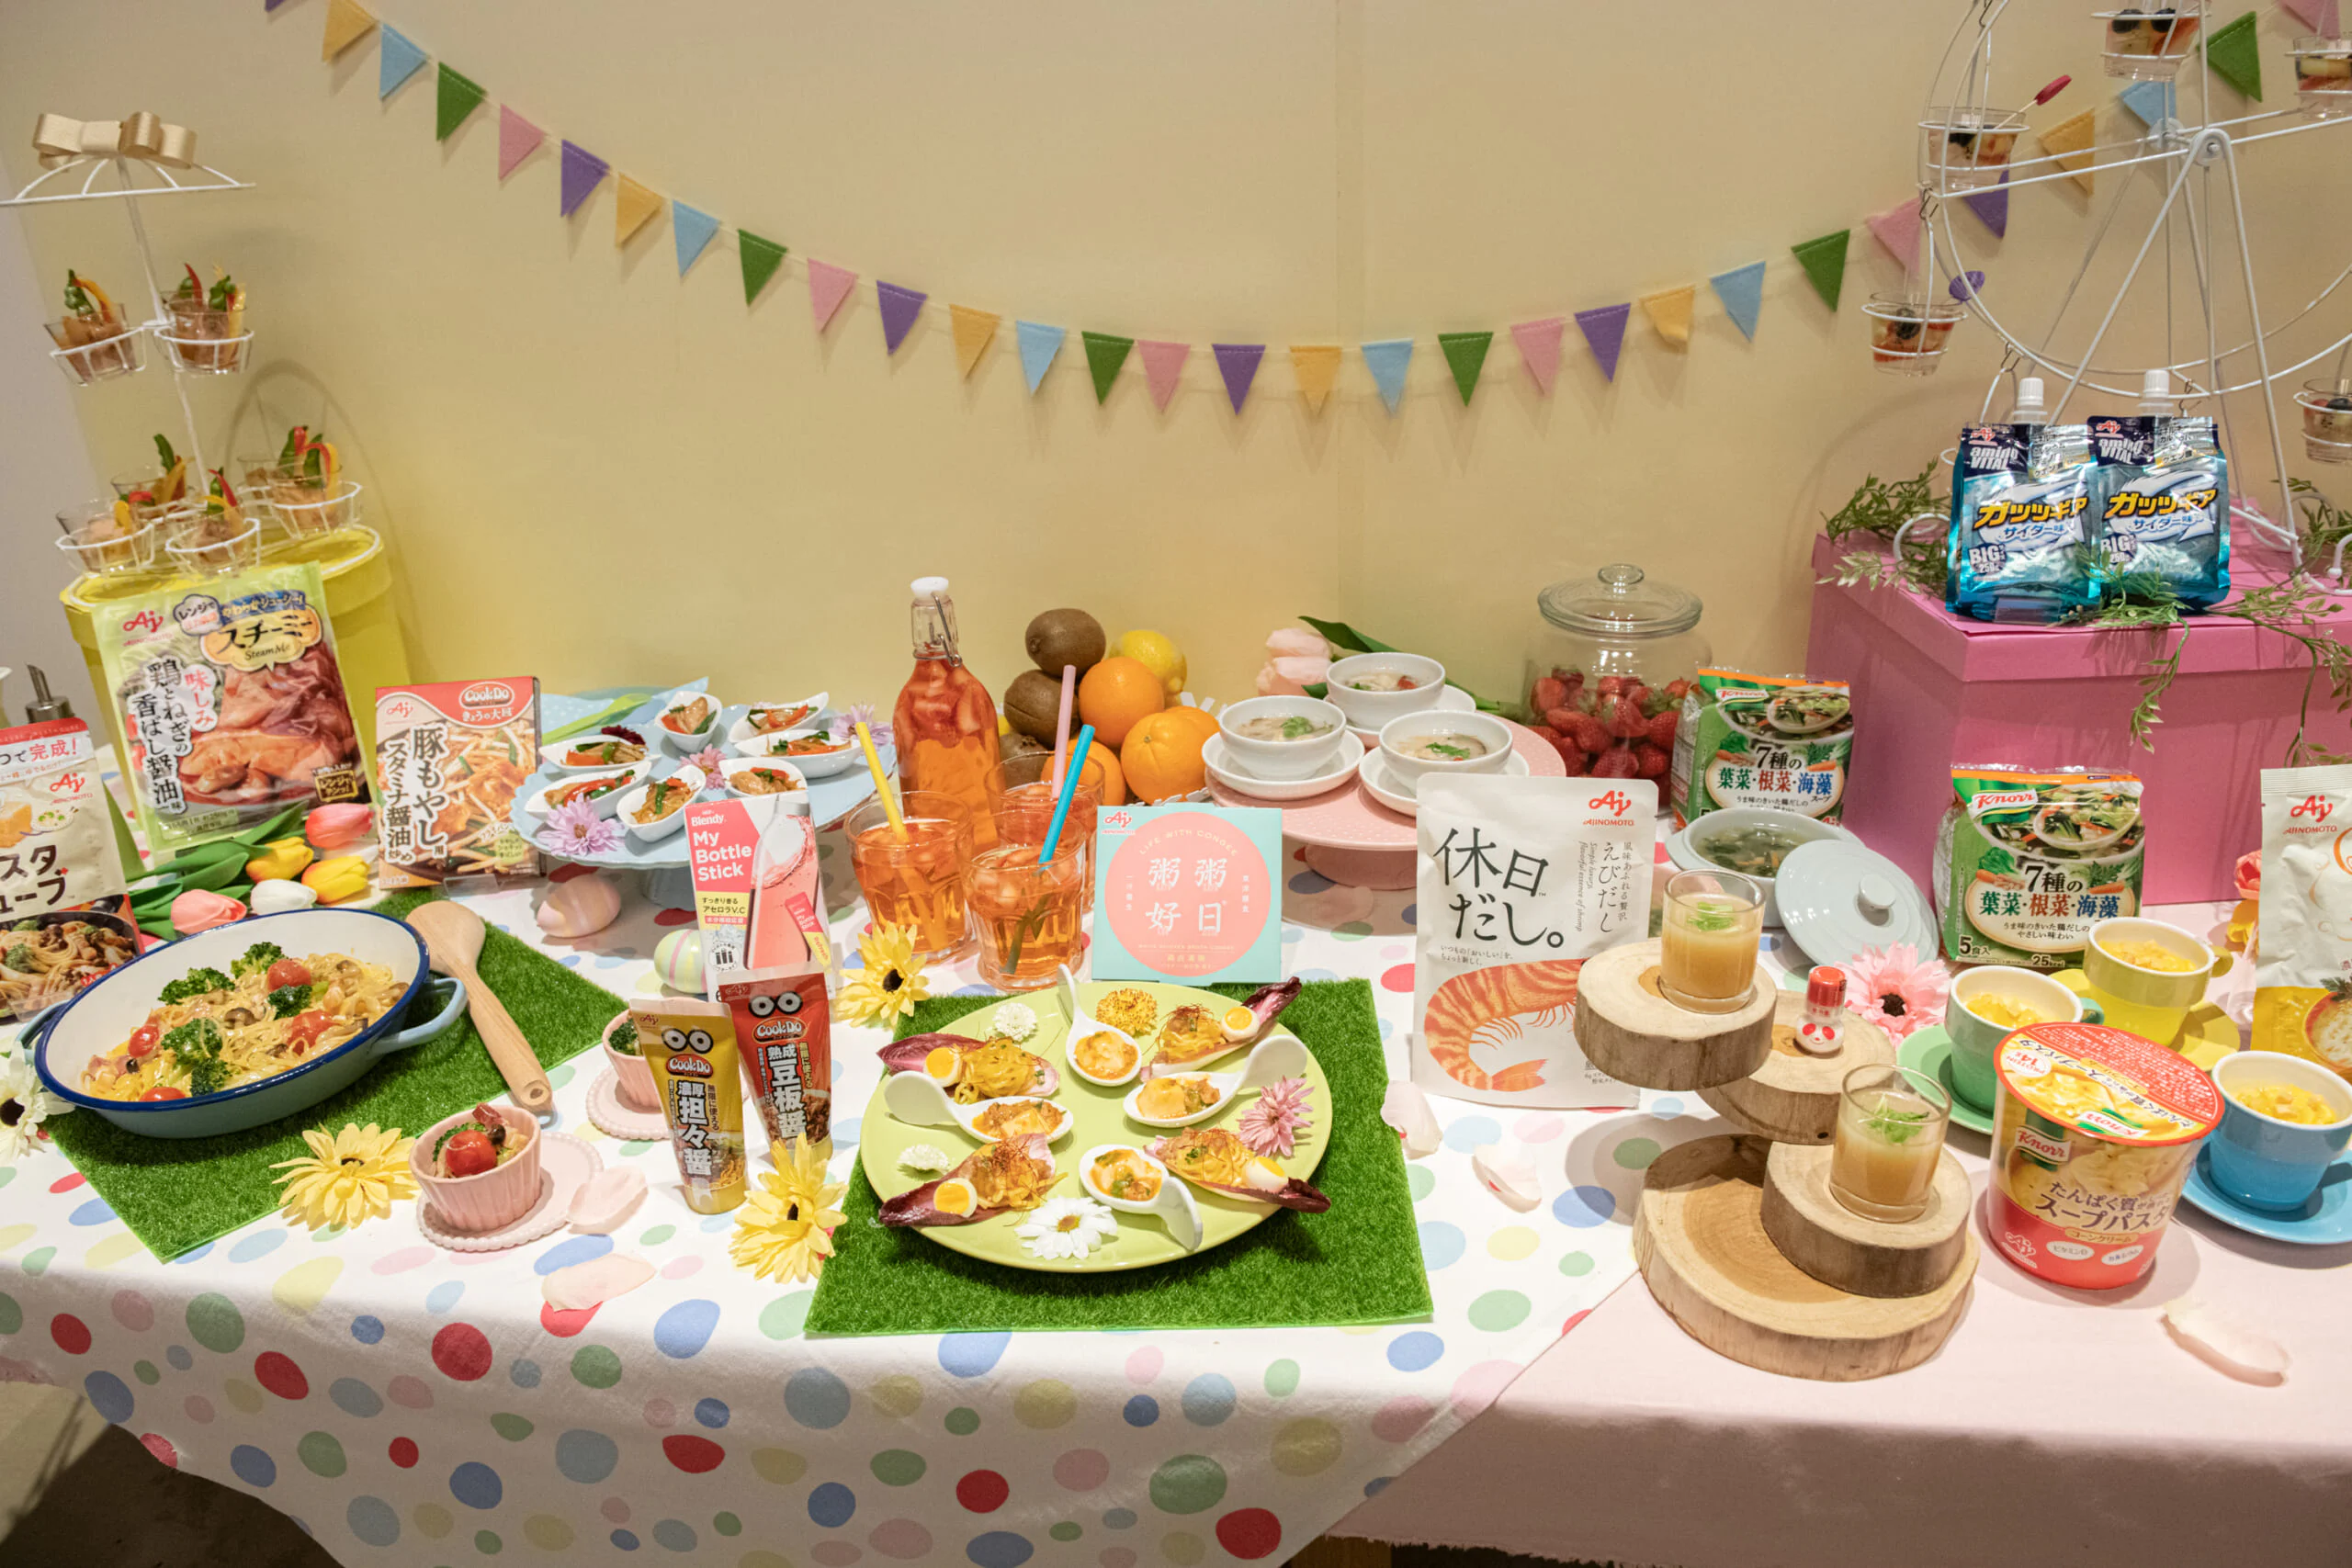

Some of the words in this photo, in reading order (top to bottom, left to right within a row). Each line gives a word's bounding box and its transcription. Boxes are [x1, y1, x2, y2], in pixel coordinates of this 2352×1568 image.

[1970, 446, 2019, 460] amino
[2100, 446, 2135, 465] VITAL
[1970, 457, 2010, 470] VITAL
[2003, 524, 2065, 539] サイダー味
[2132, 515, 2193, 530] サイダー味
[2100, 535, 2131, 552] BIG
[1969, 545, 2000, 564] BIG
[217, 615, 313, 655] スチーミー
[147, 659, 188, 753] 鶏とねぎの
[185, 669, 215, 728] 味しみ
[1756, 746, 1803, 770] 7種の
[386, 742, 413, 862] スタミナ醤油炒め
[1975, 793, 2034, 809] Knorr
[691, 814, 724, 827] Blendy
[693, 831, 719, 847] My
[1139, 837, 1161, 855] LIFE
[1166, 829, 1193, 839] WITH
[1197, 829, 1238, 856] CONGEE
[695, 846, 752, 863] Bottle
[1433, 827, 1549, 897] 休日
[697, 862, 744, 882] Stick
[2024, 865, 2084, 894] 7種の
[1599, 841, 1622, 933] えびだし
[2018, 1130, 2066, 1158] Knorr
[2035, 1193, 2170, 1232] スープパスタ
